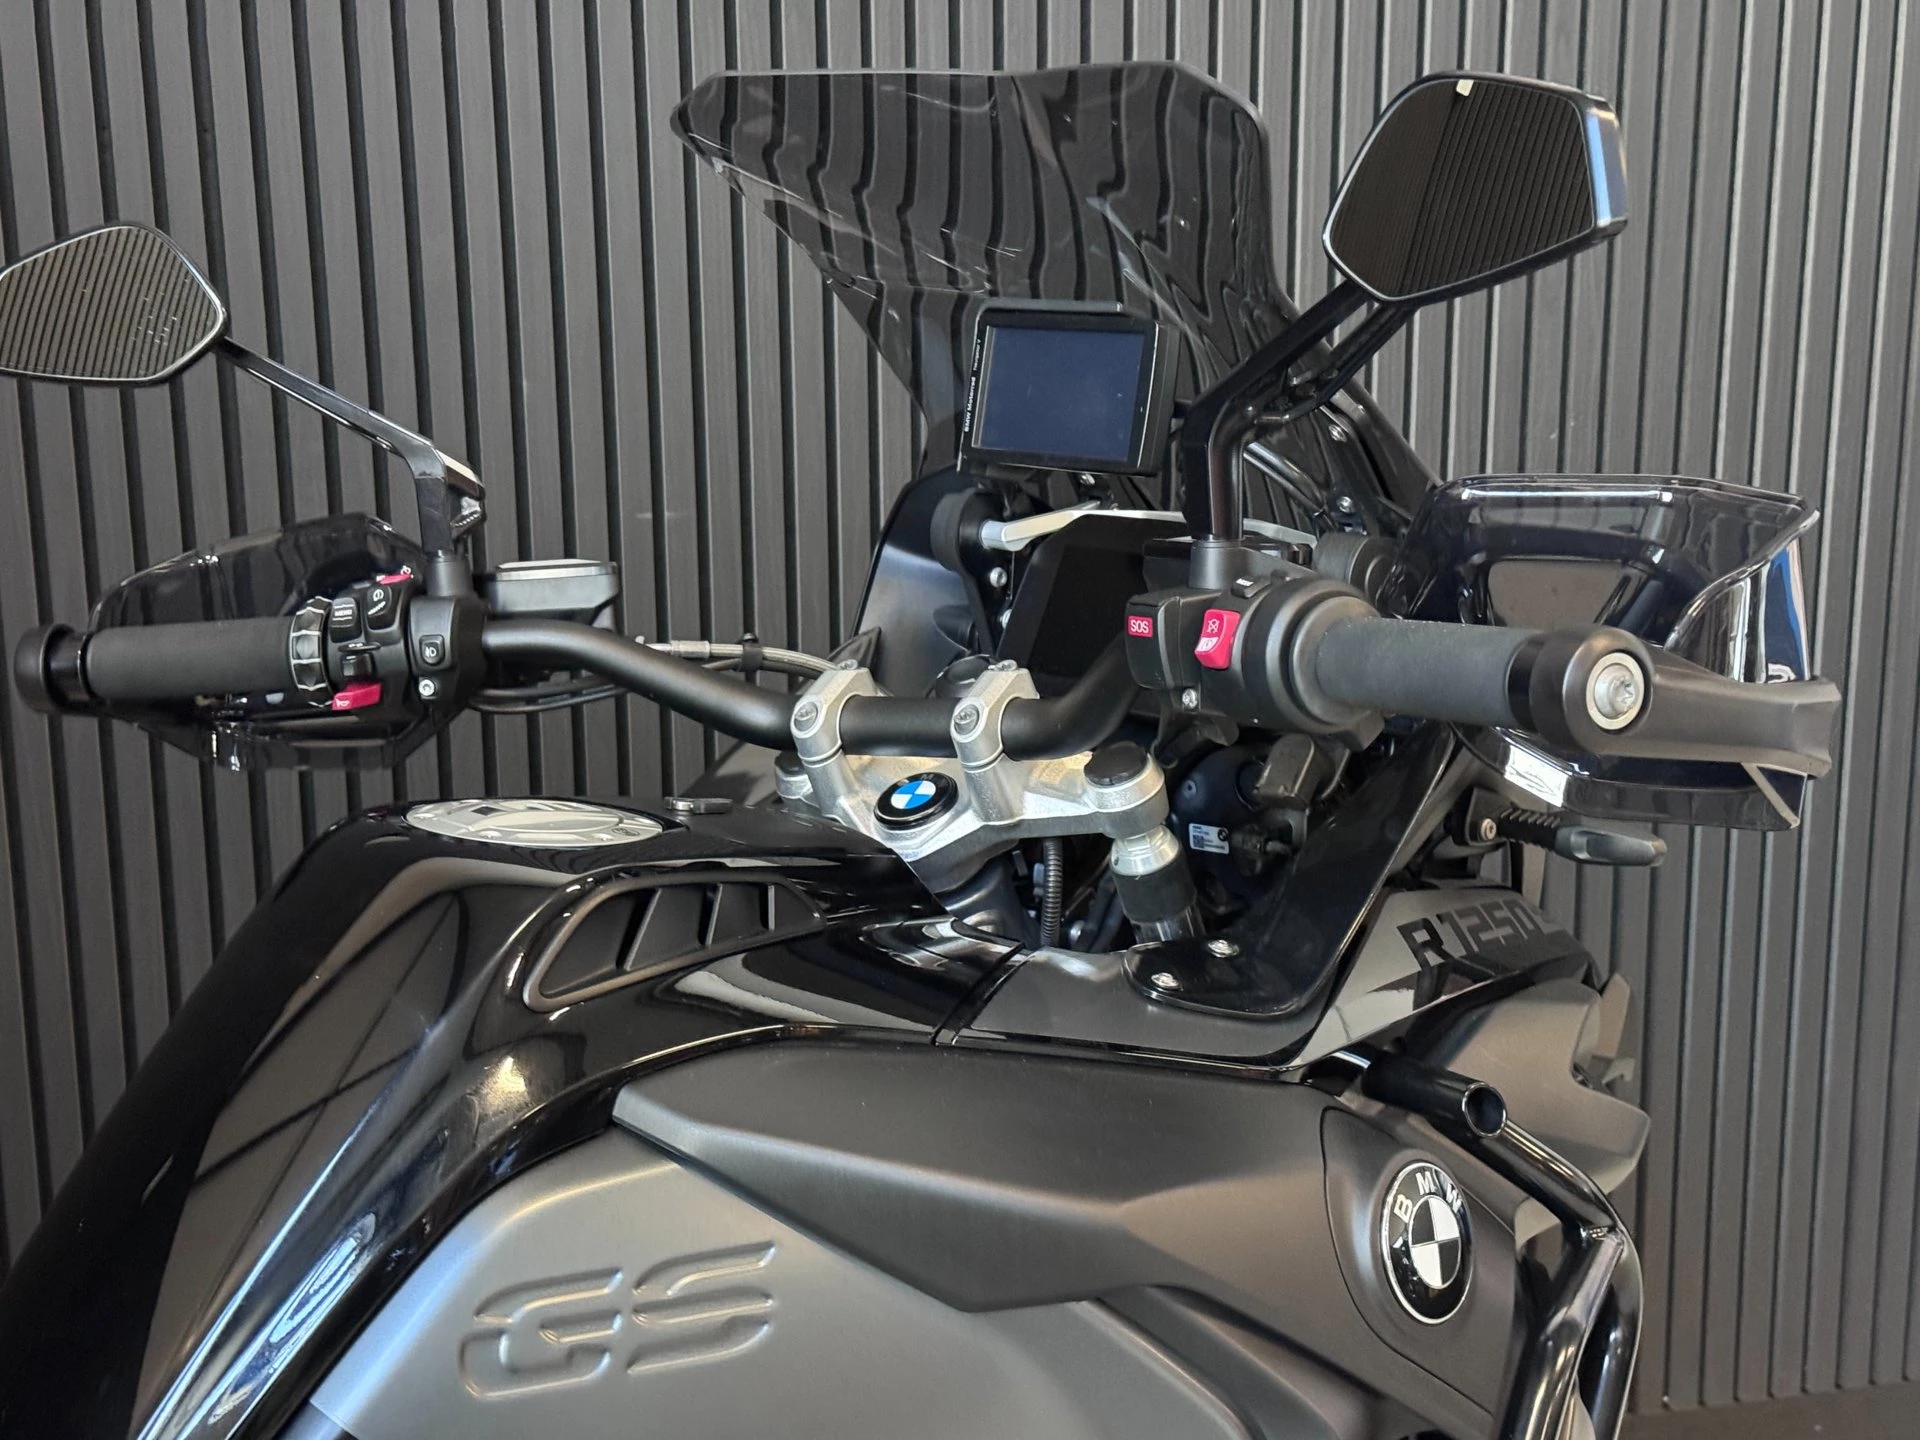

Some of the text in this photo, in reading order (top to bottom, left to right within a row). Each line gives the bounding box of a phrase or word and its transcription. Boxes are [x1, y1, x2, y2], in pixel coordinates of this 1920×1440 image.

[1130, 619, 1149, 634] SOS
[1393, 1169, 1463, 1224] BMW
[457, 1239, 776, 1399] GS
